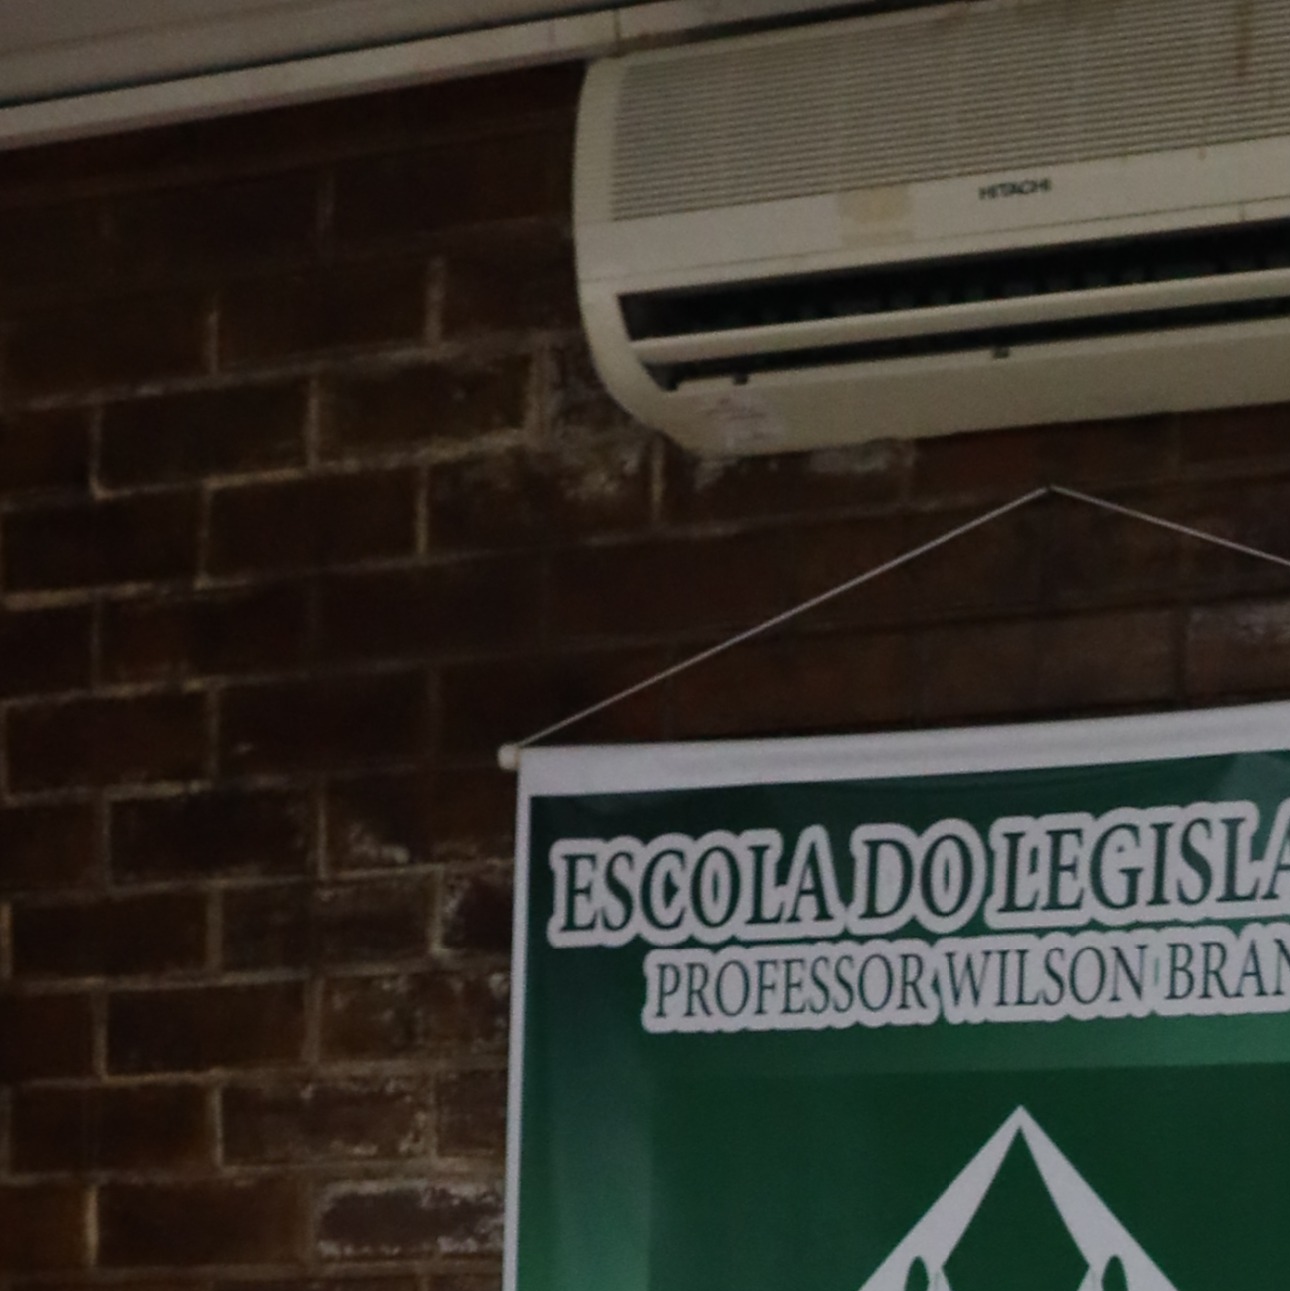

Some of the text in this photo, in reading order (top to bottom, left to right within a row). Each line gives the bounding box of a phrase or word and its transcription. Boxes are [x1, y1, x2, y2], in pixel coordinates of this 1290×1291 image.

[560, 840, 836, 933] ESCOLA
[858, 833, 974, 919] DO
[655, 953, 928, 1019] PROFESSOR
[945, 944, 1148, 1008] WILSON
